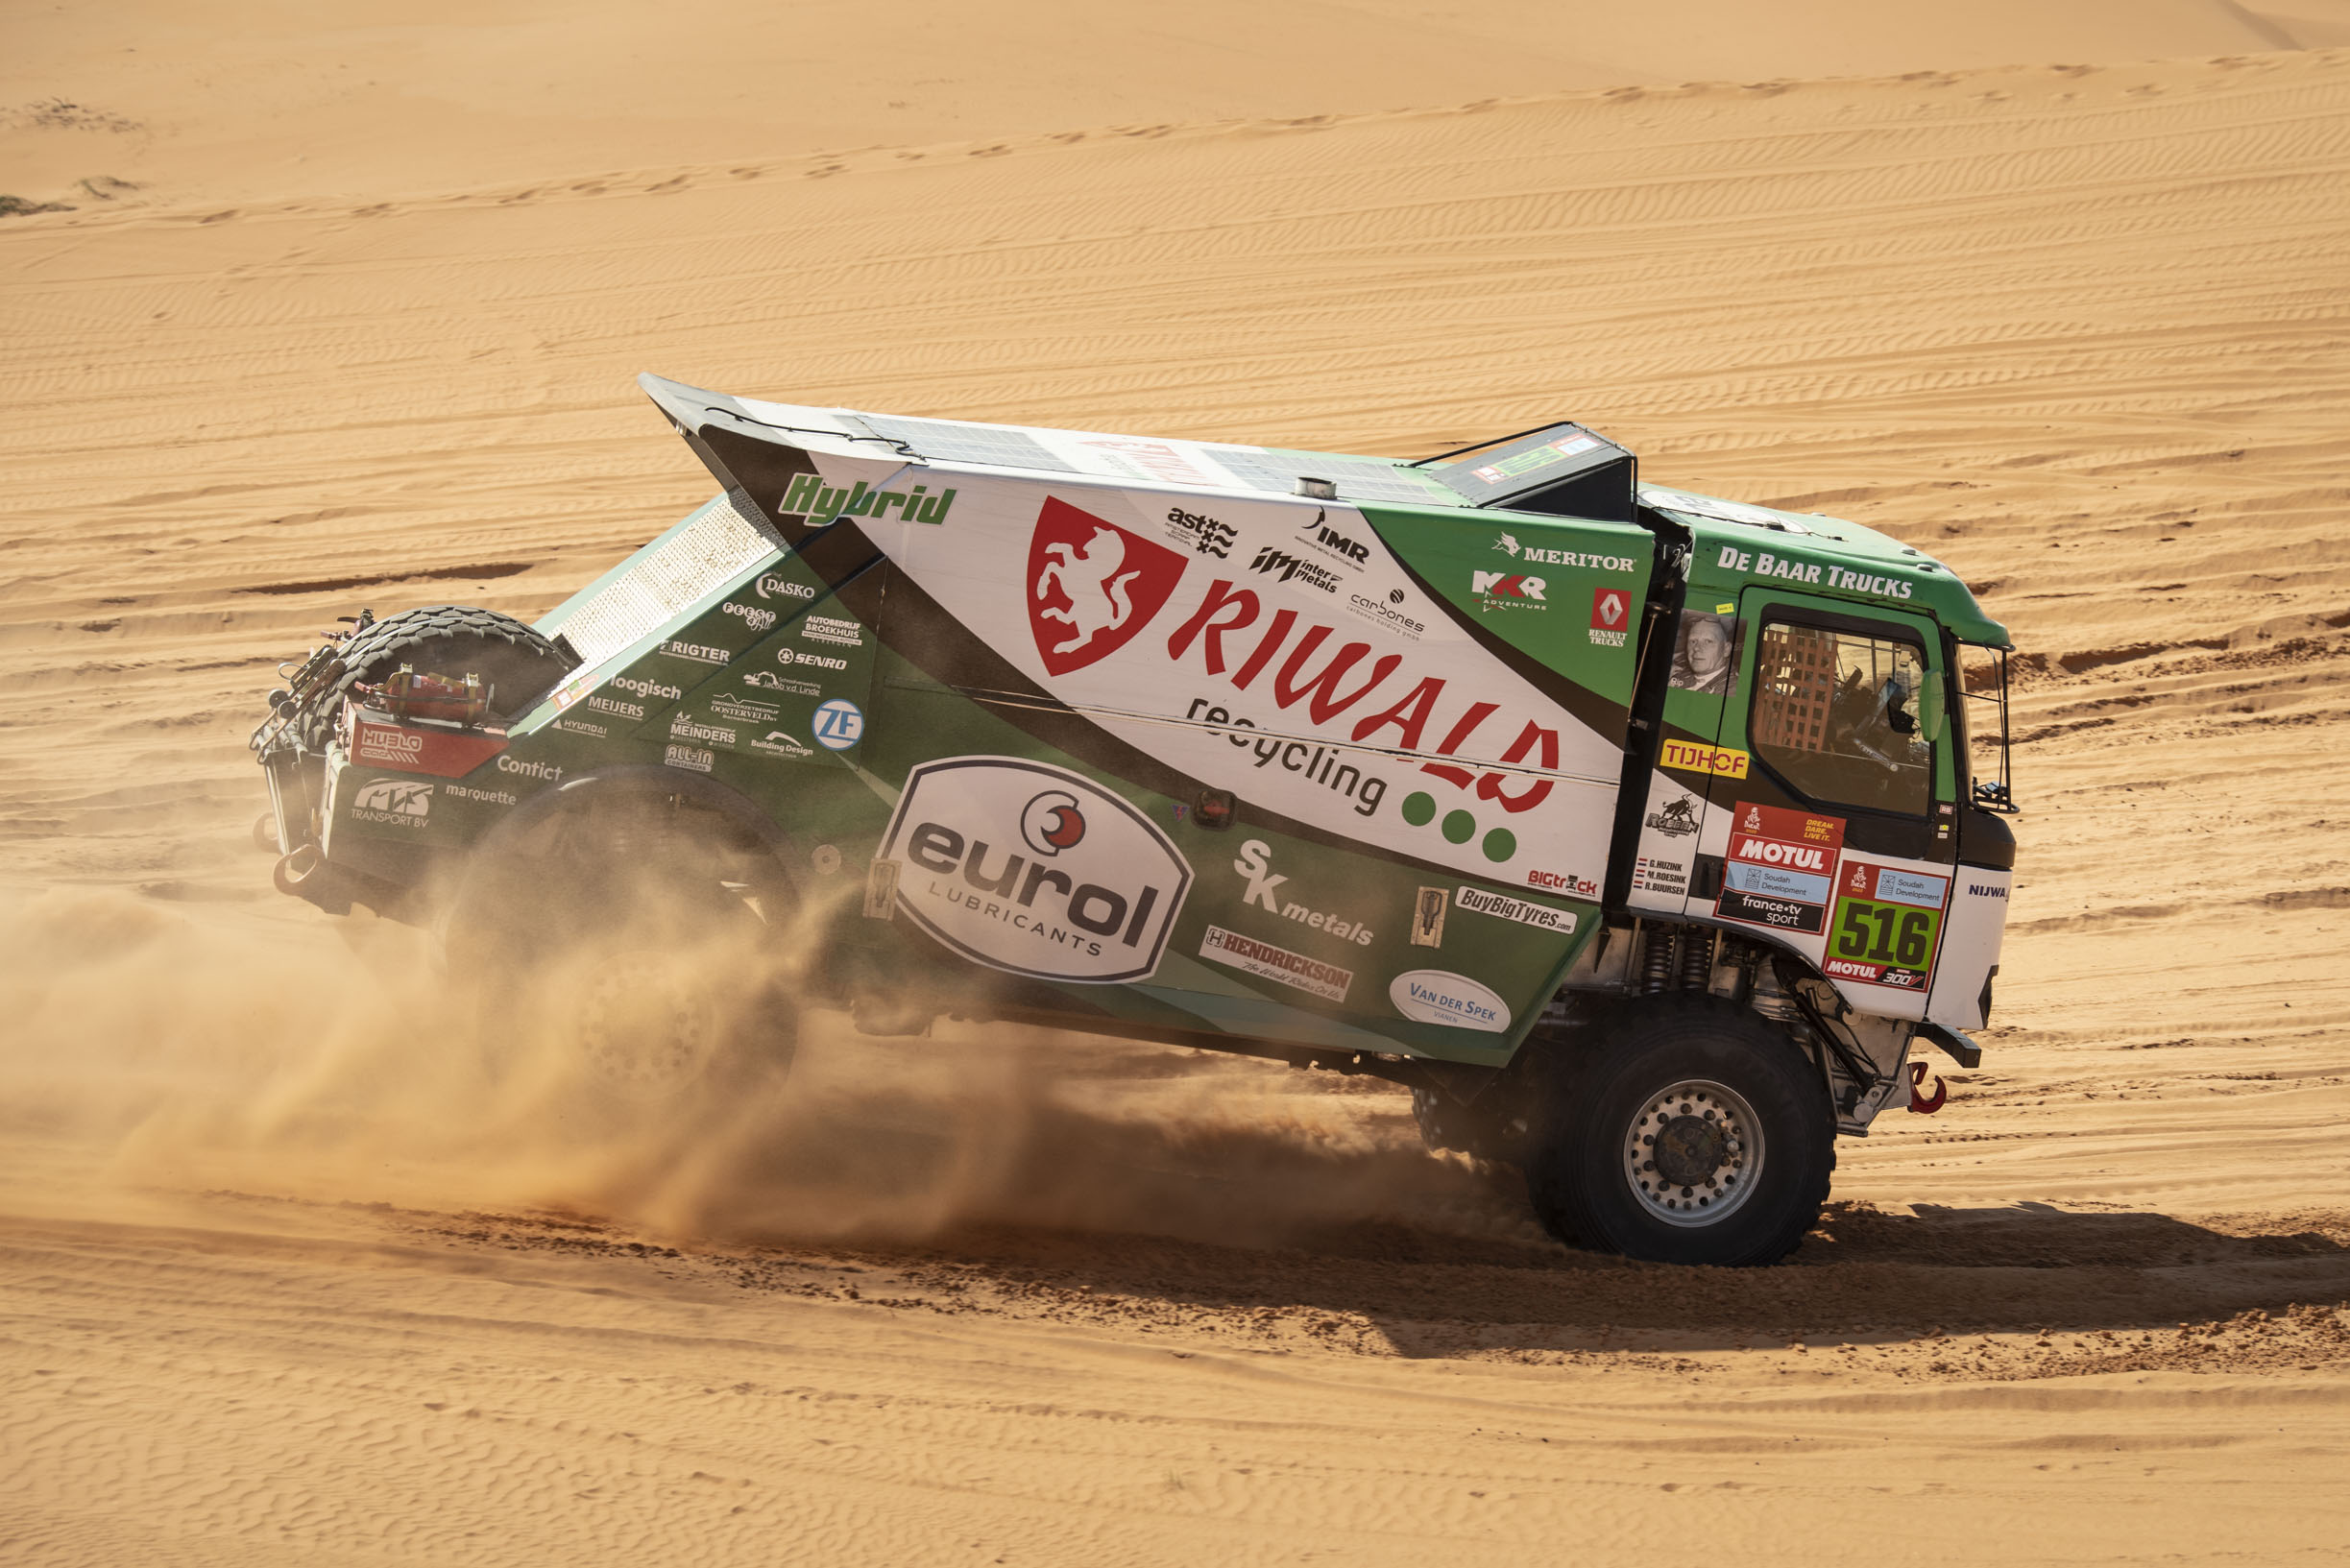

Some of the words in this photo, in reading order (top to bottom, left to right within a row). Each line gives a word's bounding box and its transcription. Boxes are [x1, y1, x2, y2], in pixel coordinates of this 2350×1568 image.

[780, 474, 958, 525] Hybrid
[1167, 507, 1206, 534] ast
[1318, 526, 1369, 565] IMR
[1524, 546, 1634, 572] MERITOR
[1300, 559, 1331, 580] inter
[766, 578, 815, 599] DASKO
[723, 602, 776, 621] FEEST
[1351, 593, 1425, 633] carbones
[1483, 599, 1547, 611] ADVENTURE
[806, 623, 860, 639] BROEKHUIS
[807, 615, 861, 631] AUTOBEDRIJF
[1588, 629, 1627, 640] RENAULT
[1589, 636, 1624, 647] TRUCKS
[672, 641, 730, 662] RIGTER
[794, 653, 847, 670] SENRO
[799, 685, 820, 695] Linde
[1168, 578, 1560, 813] RIWALD
[588, 695, 644, 717] MEIJERS
[711, 706, 770, 721] OOSTERVELD
[670, 723, 737, 744] MEINDERS
[816, 705, 862, 743] ZF
[666, 745, 714, 765] ALL-IN
[750, 739, 785, 753] Building
[786, 744, 813, 757] Design
[1186, 697, 1388, 816] recycling
[497, 755, 564, 782] Contict
[1666, 744, 1746, 773] TIJHOF
[446, 784, 517, 806] marquette
[351, 808, 413, 826] TRANSPORT
[414, 817, 429, 828] BV
[1804, 832, 1820, 841] LIVE
[1738, 839, 1824, 870] MOTUL
[1649, 858, 1683, 872] G.HUZINK
[908, 822, 1159, 949] eurol
[1527, 869, 1597, 895] BIGtrck
[1647, 871, 1687, 884] M.ROESINK
[1764, 873, 1791, 883] Soudah
[1898, 879, 1925, 889] Soudah
[1645, 881, 1685, 895] R.BUURSEN
[1761, 882, 1807, 896] Development
[1895, 887, 1940, 902] Development
[1969, 884, 2006, 898] NIJWA
[929, 880, 1102, 957] LUBRICANTS
[1281, 902, 1374, 946] metals
[1766, 912, 1800, 926] sport
[1838, 902, 1930, 966] 516
[1223, 933, 1351, 989] HENDRICKSON
[1827, 960, 1878, 978] MOTUL
[1259, 966, 1290, 982] World
[1882, 972, 1924, 986] 300V
[1434, 1010, 1458, 1024] VIANEN
